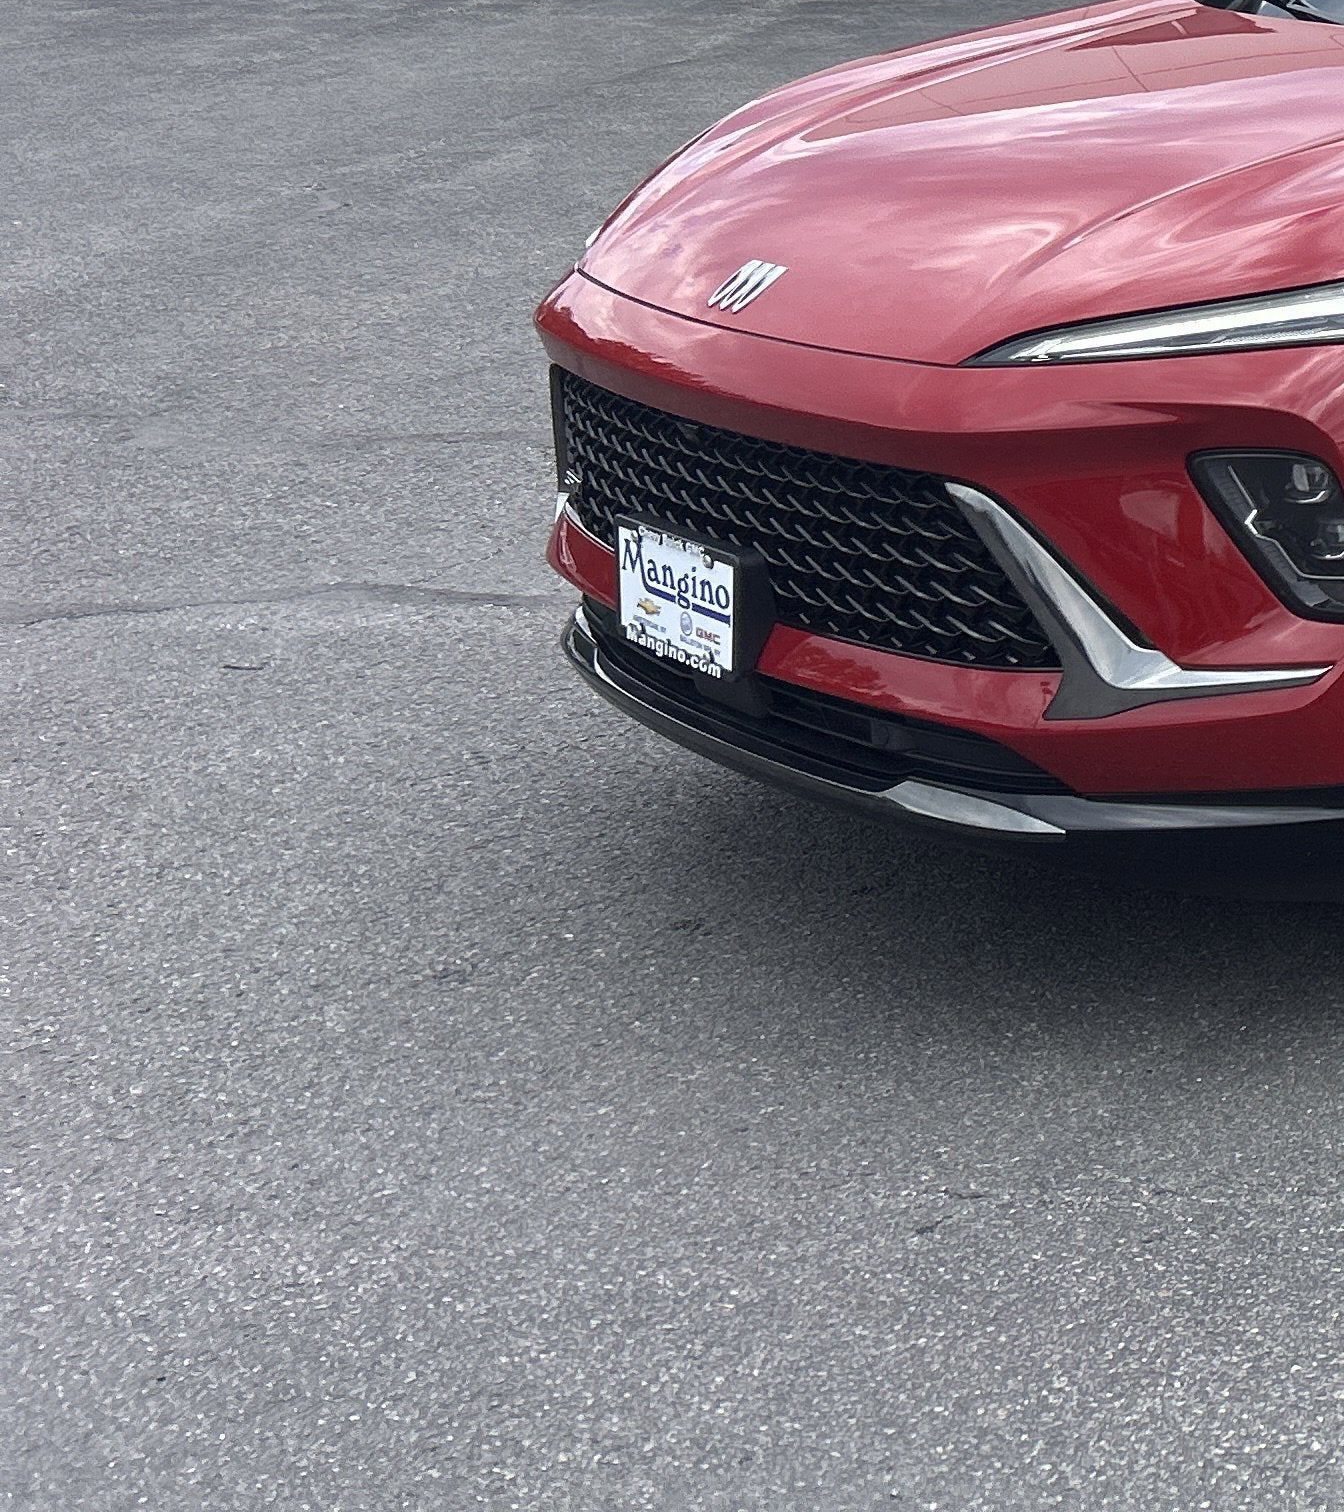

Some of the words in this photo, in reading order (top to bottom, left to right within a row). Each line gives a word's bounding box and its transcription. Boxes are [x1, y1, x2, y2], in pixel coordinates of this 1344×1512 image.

[622, 537, 730, 610] Mangino
[626, 622, 722, 679] Mangino.com
[696, 627, 721, 646] GMC
